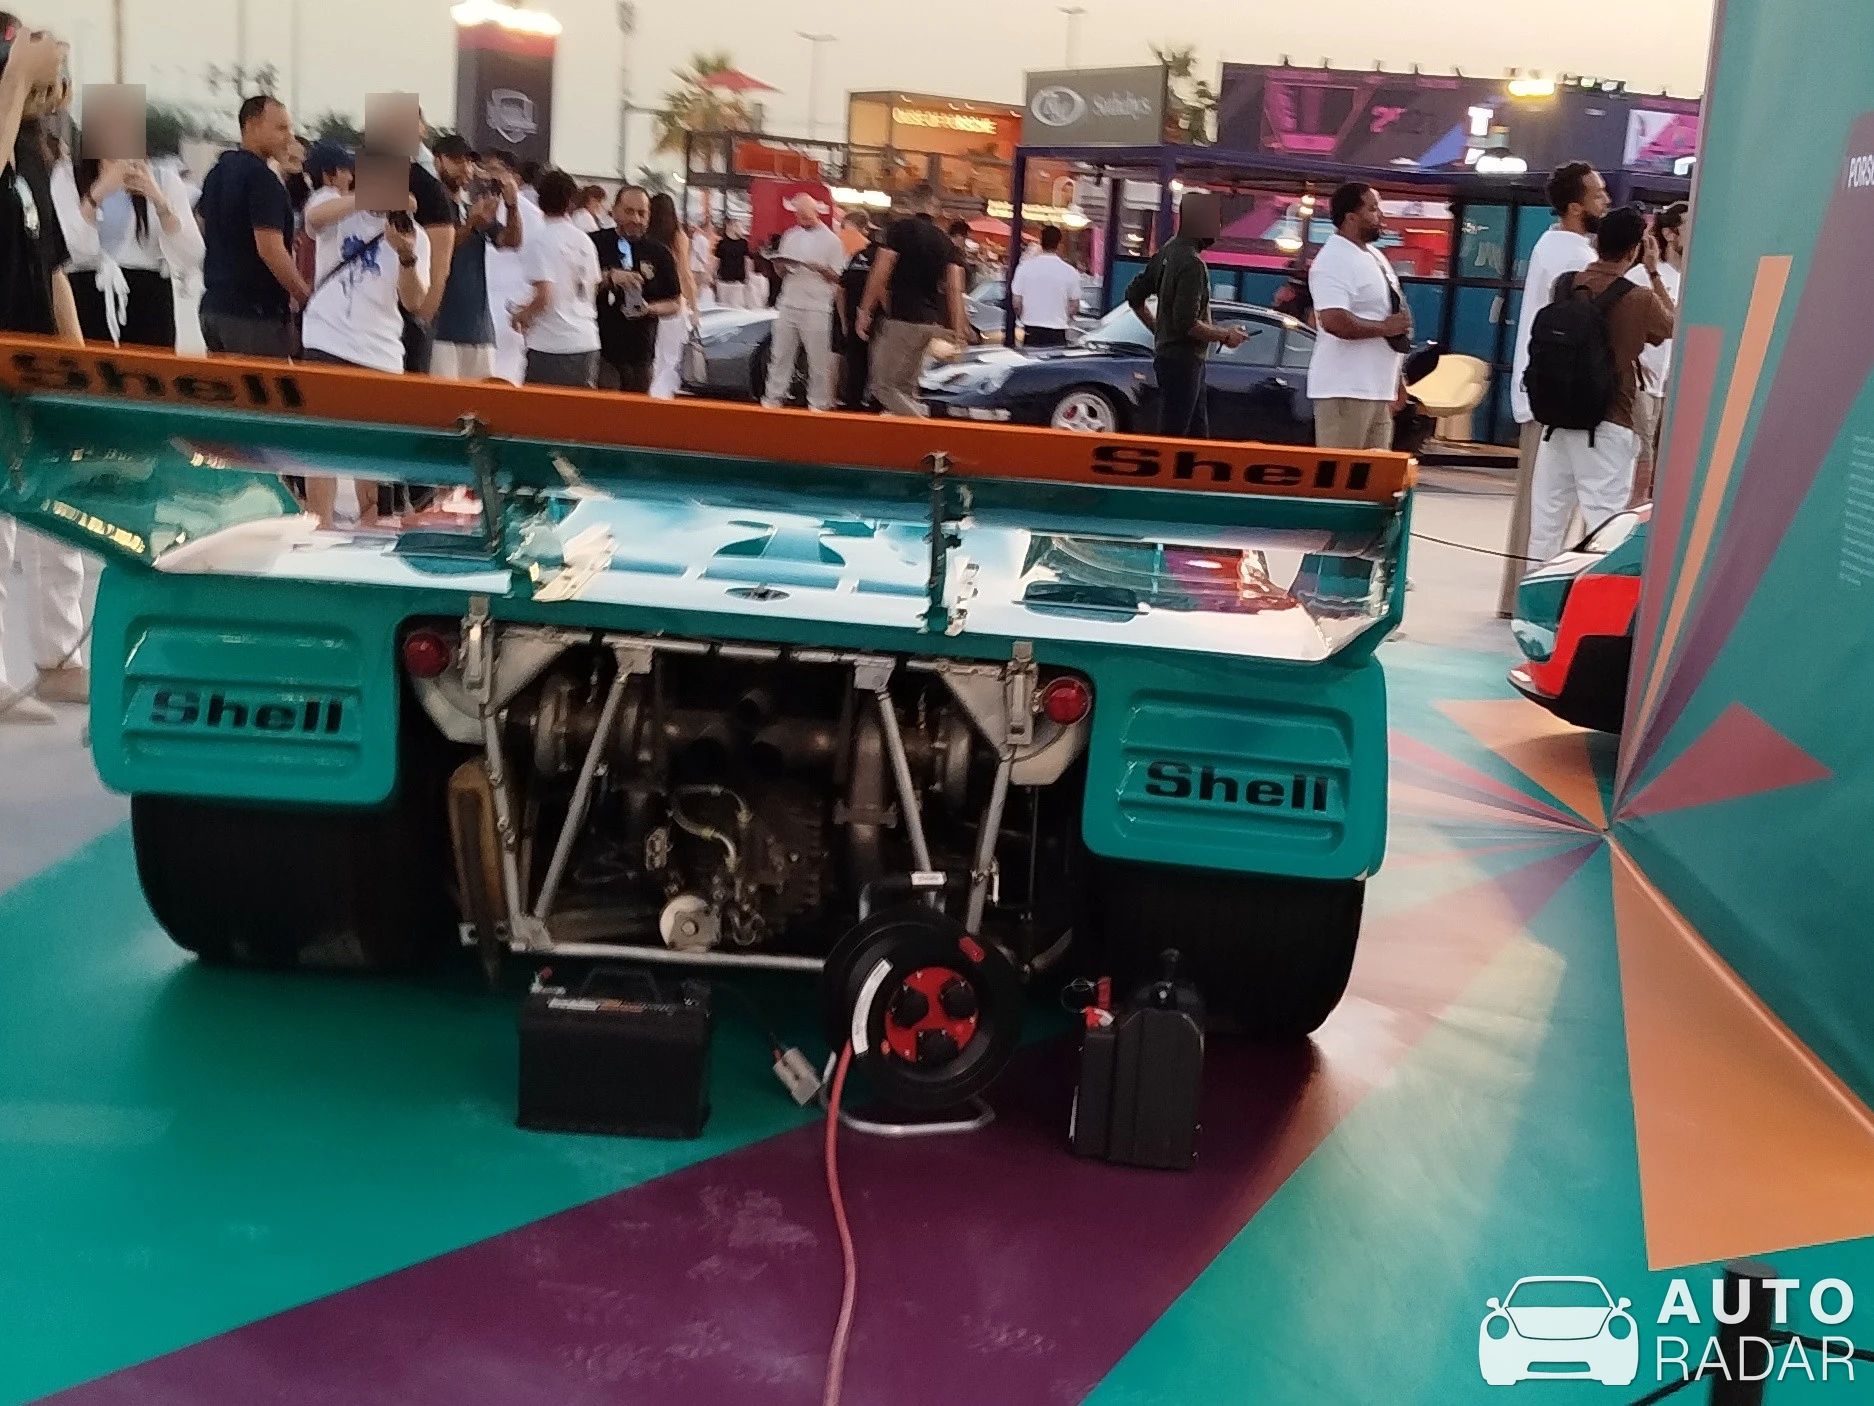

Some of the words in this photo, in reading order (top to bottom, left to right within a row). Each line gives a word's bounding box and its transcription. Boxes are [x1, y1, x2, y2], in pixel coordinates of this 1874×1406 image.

[13, 355, 304, 407] Shell
[1092, 446, 1370, 489] Shell
[152, 691, 344, 734] Shell
[1147, 763, 1327, 810] Shell
